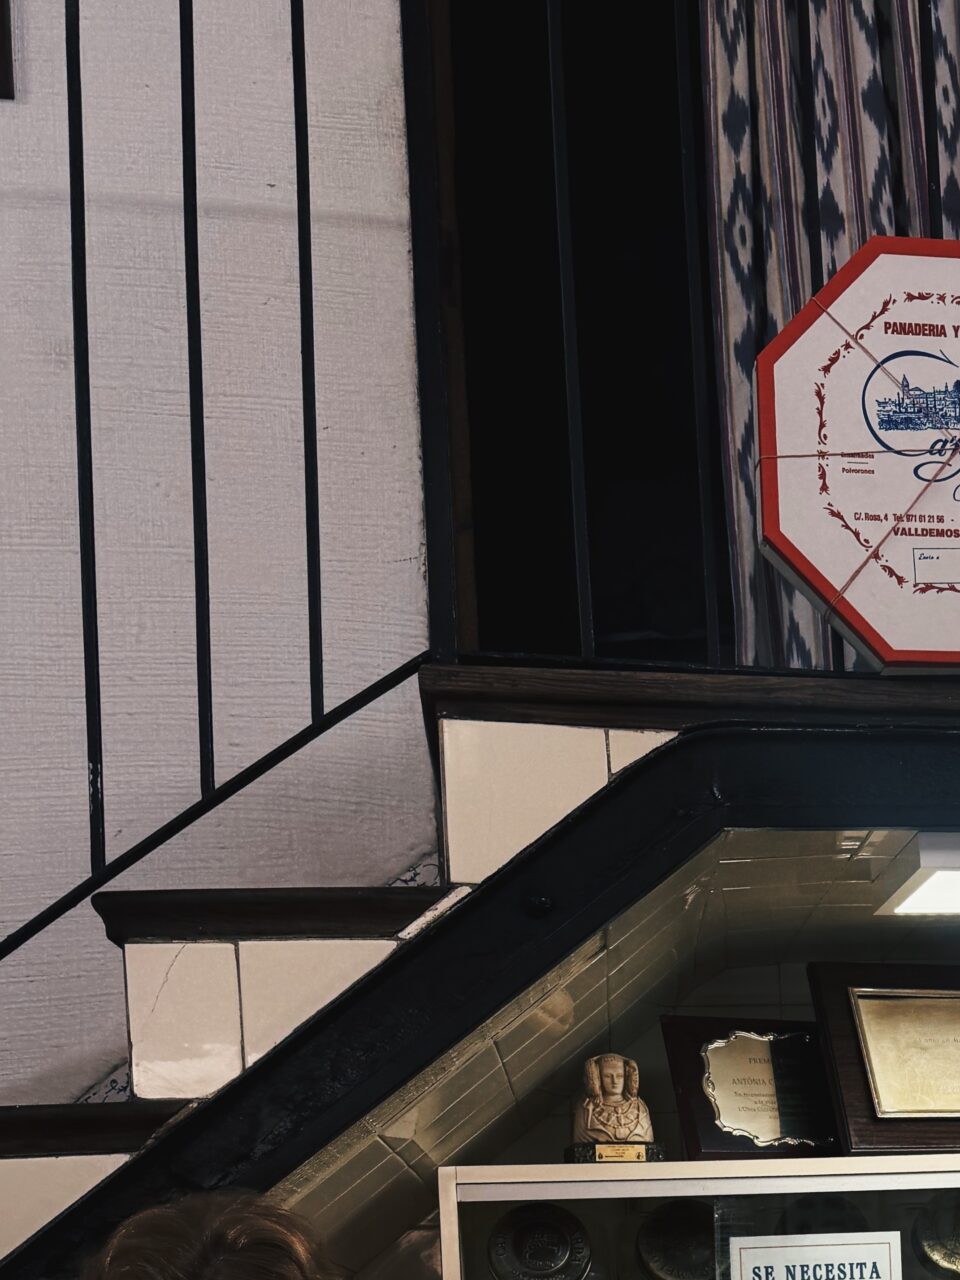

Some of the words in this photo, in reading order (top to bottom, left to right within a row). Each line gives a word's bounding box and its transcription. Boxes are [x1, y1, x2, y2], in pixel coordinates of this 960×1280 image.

[883, 321, 947, 338] PANADERIA
[952, 324, 960, 338] Y
[884, 513, 889, 521] 4
[928, 515, 935, 523] 21
